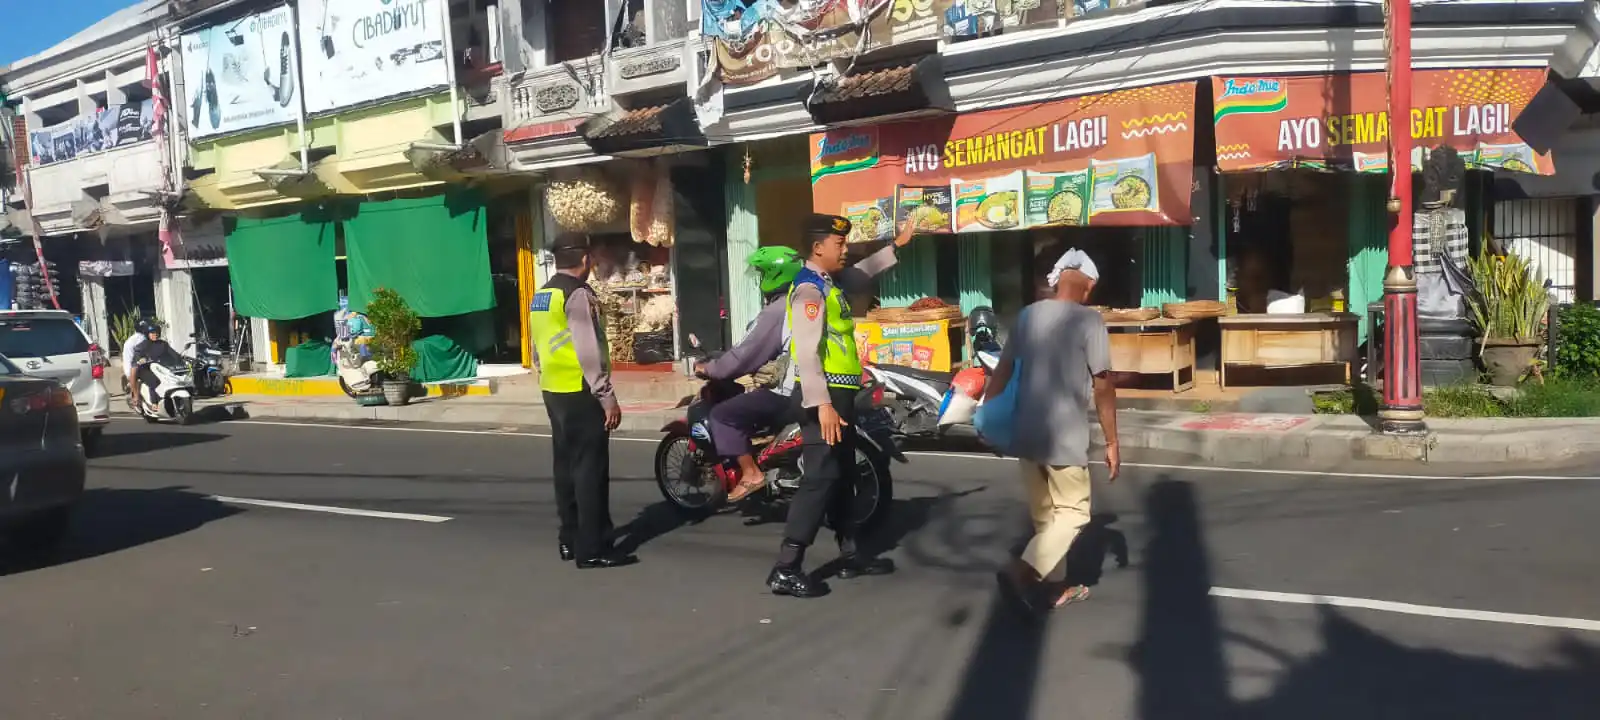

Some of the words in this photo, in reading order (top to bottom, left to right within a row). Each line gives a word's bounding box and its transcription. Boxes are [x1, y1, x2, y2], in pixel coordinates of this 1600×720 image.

[905, 144, 939, 173] AYO
[943, 126, 1048, 168] SEMANGAT
[1053, 115, 1108, 152] LAGI!
[1278, 117, 1320, 151] AYO
[1326, 106, 1448, 147] SEMAGAT
[1453, 103, 1510, 136] LAGI!
